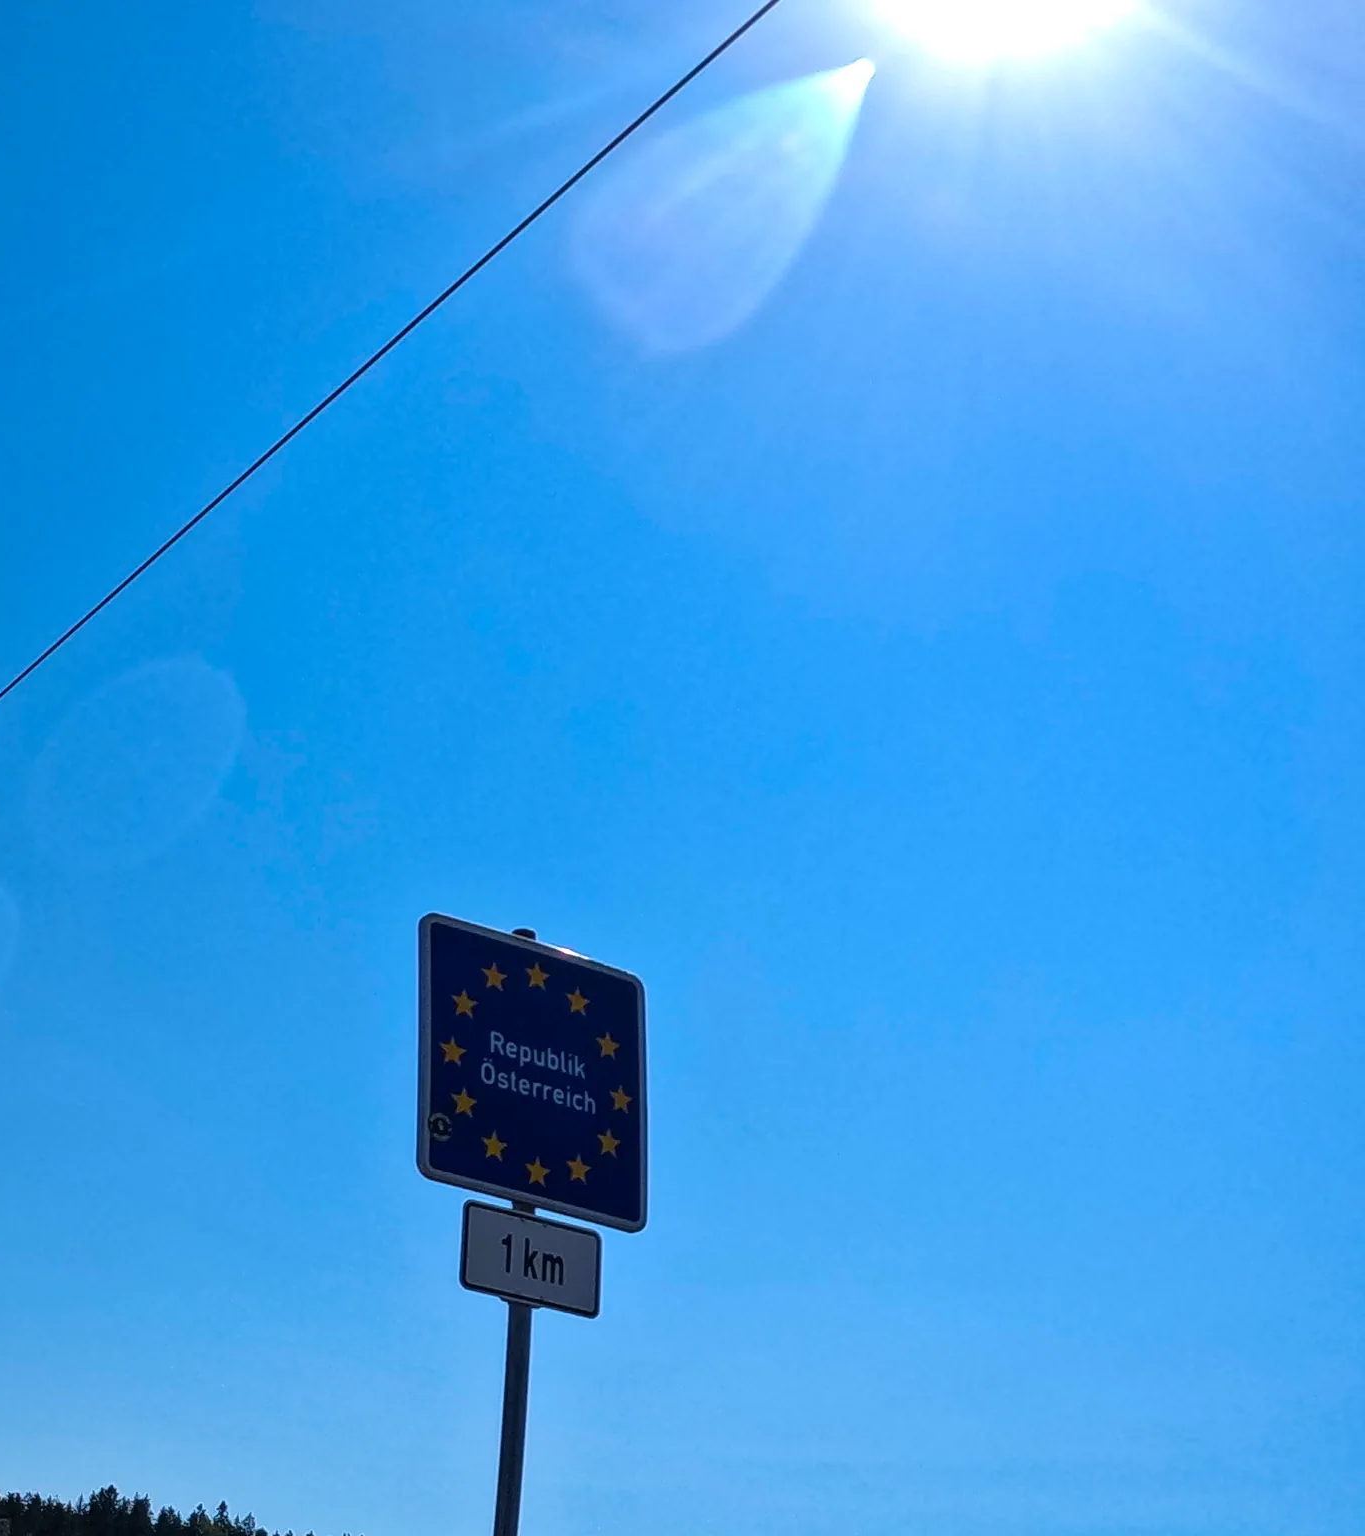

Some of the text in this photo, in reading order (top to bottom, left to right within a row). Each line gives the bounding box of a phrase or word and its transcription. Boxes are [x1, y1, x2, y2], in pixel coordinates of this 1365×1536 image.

[490, 1031, 586, 1079] Republik
[480, 1057, 596, 1115] Österreich
[500, 1233, 565, 1286] 1 km
